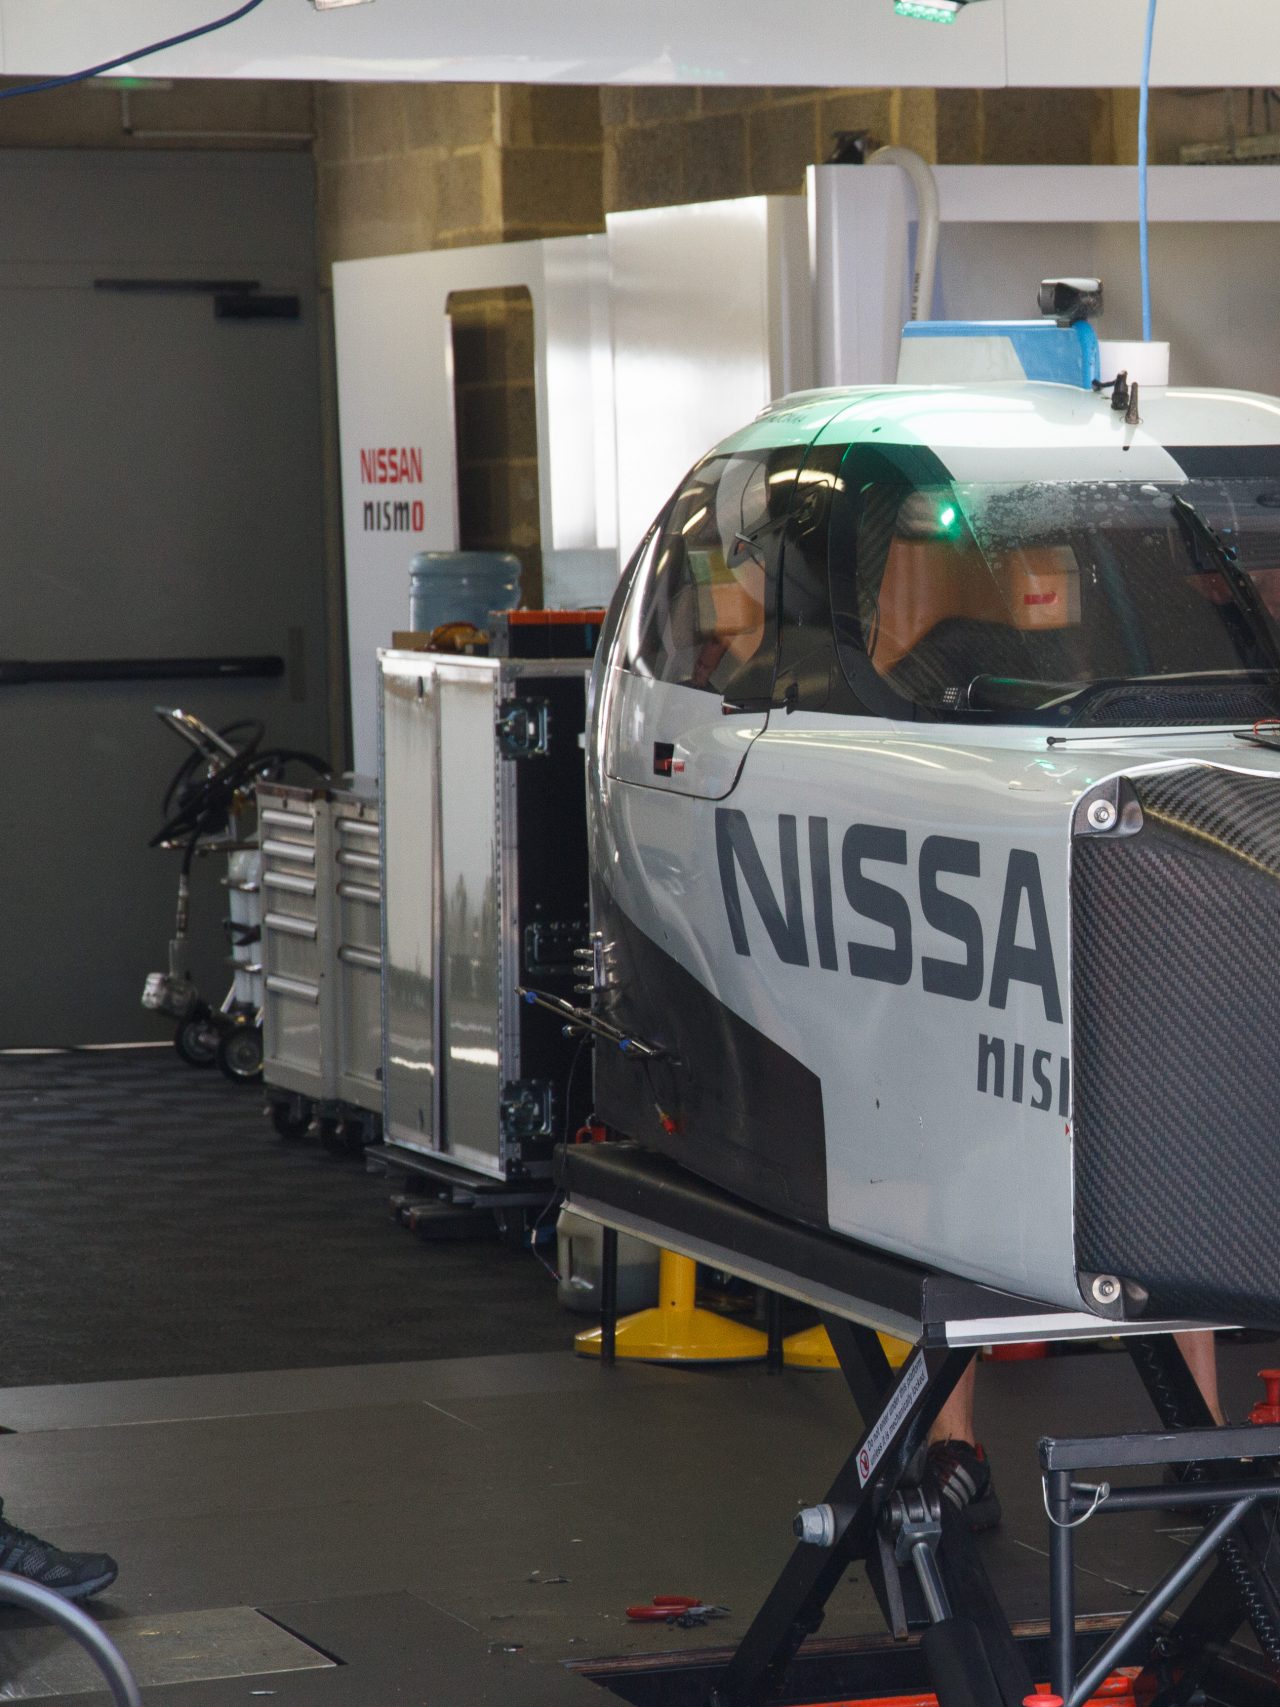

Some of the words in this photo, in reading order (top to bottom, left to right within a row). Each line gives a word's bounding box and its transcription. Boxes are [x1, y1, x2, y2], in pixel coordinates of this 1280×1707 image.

[360, 447, 424, 484] NISSAN
[363, 501, 425, 532] nismo
[714, 807, 1064, 1024] NISSA
[872, 1426, 881, 1442] not
[879, 1411, 889, 1432] enter
[888, 1393, 900, 1417] under
[898, 1382, 908, 1399] this
[907, 1357, 924, 1388] platform
